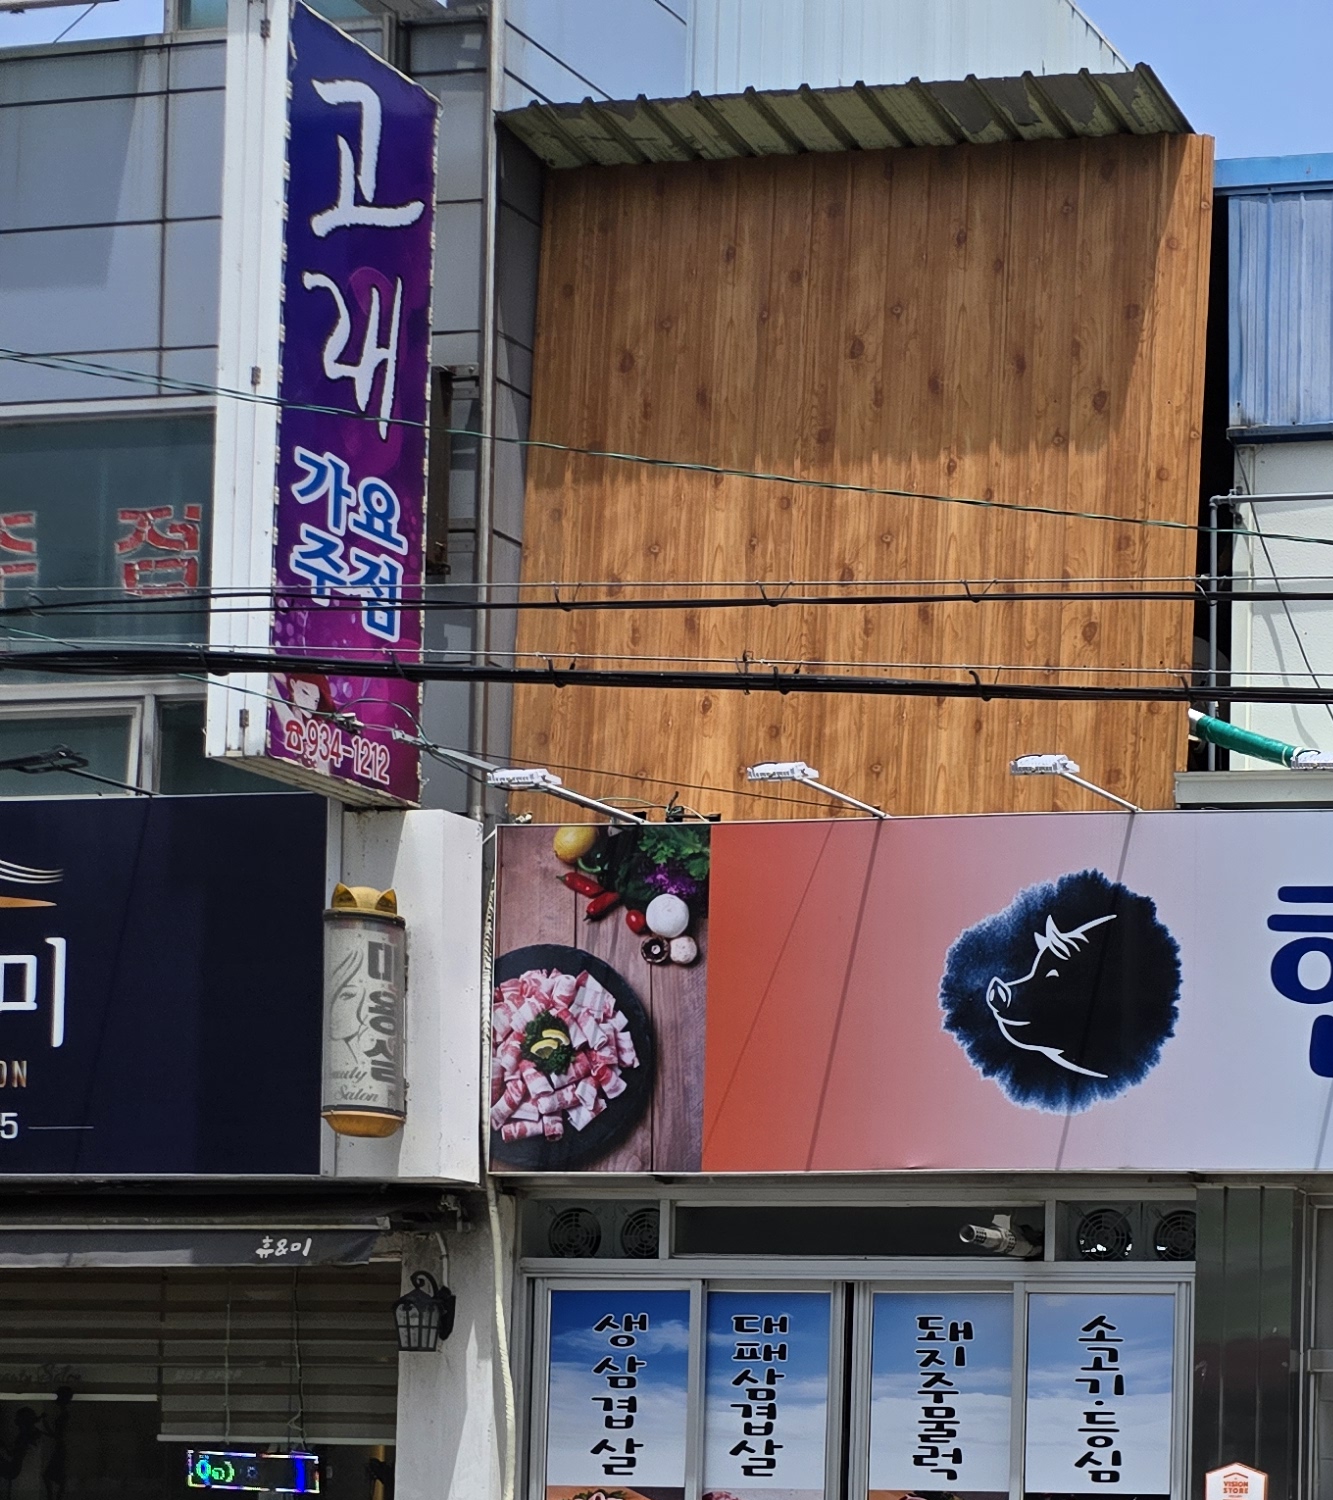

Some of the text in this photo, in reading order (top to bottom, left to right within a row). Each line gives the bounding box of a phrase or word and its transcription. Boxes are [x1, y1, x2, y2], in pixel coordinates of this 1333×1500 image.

[302, 78, 425, 441] 고래
[291, 447, 408, 555] 가요
[291, 530, 403, 643] 주점
[306, 720, 390, 784] 934-1212
[590, 1312, 649, 1476] 생삼겹살
[729, 1314, 789, 1477] 대패삼겹살
[912, 1315, 974, 1480] 돼지주물럭
